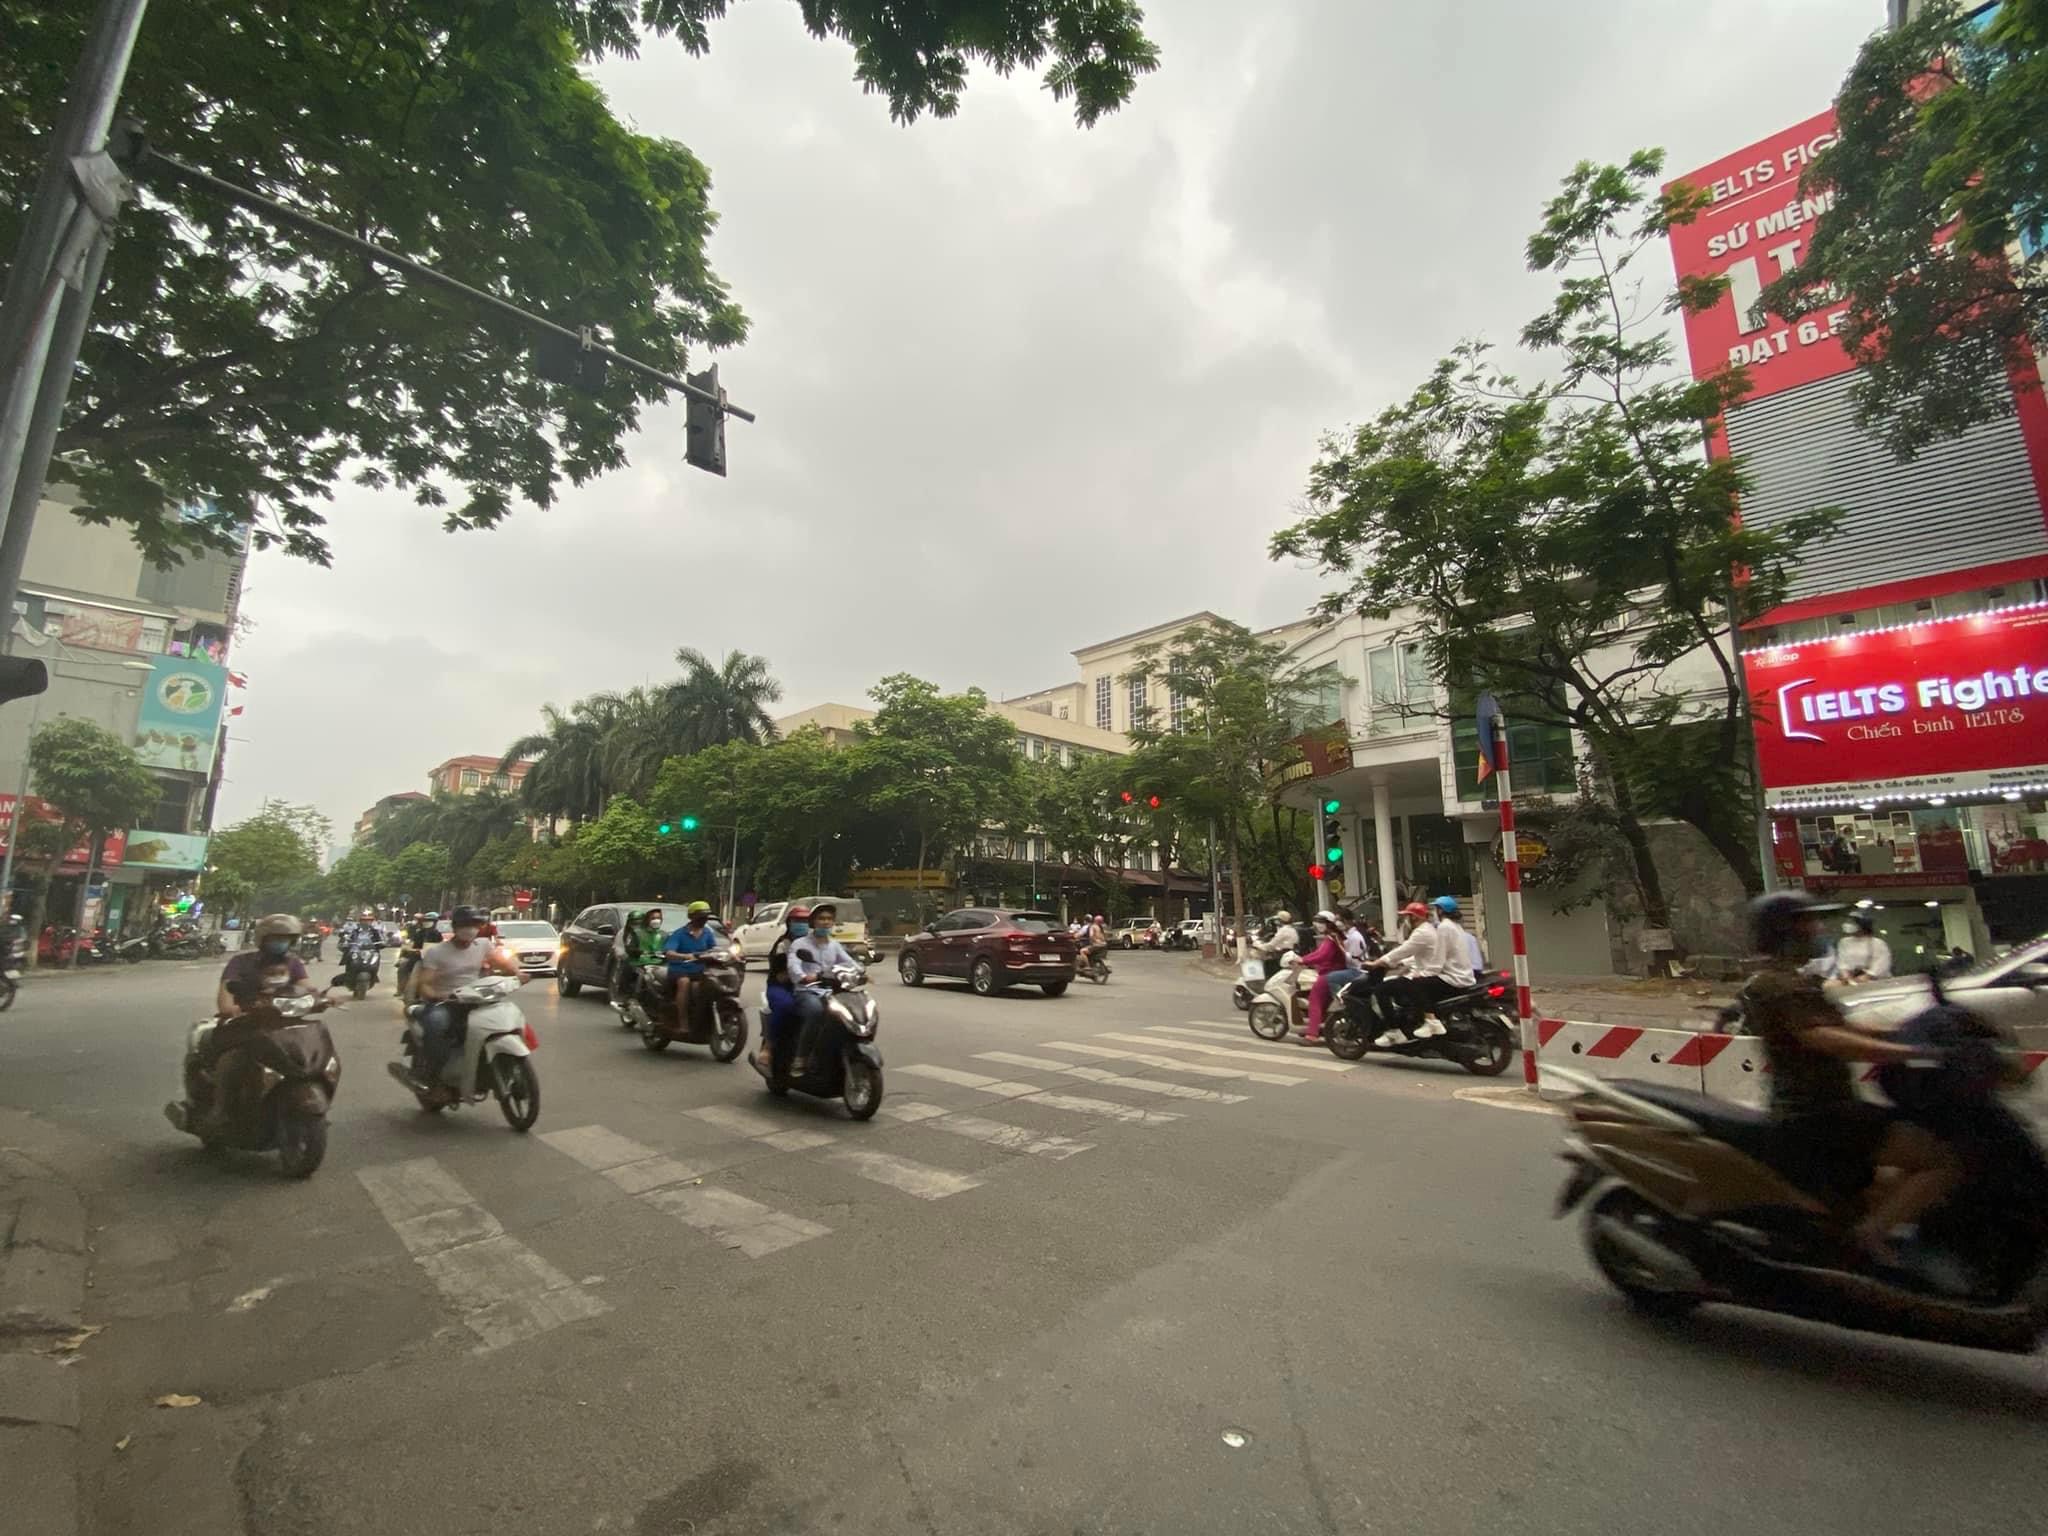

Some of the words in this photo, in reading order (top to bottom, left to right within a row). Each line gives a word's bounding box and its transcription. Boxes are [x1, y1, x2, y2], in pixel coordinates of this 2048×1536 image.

[1707, 221, 1750, 258] SỨ
[1801, 683, 1905, 722] IELTS
[1847, 722, 1902, 741] Chiến
[1914, 716, 1955, 735] binh
